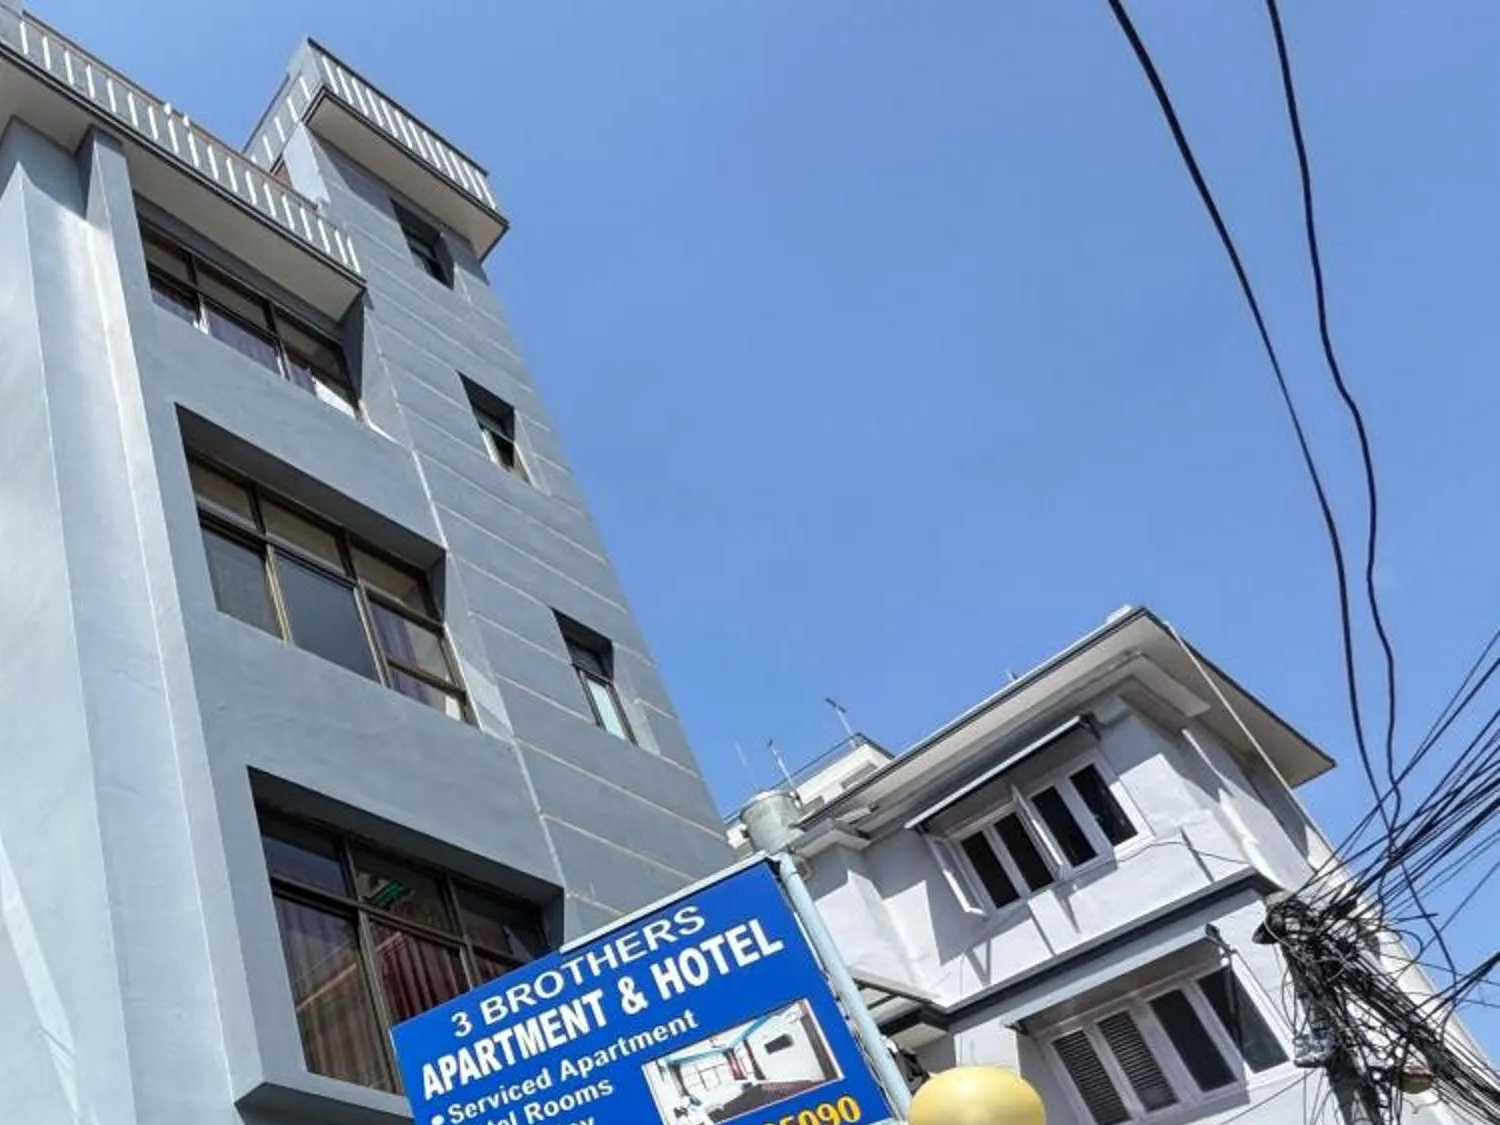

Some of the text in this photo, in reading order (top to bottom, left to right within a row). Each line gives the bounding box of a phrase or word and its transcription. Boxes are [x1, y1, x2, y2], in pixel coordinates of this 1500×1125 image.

[422, 918, 785, 1101] APARTMENT & HOTEL
[451, 906, 705, 1038] 3 BROTHERS
[447, 1008, 700, 1125] Serviced Apartment
[523, 1079, 614, 1125] Rooms
